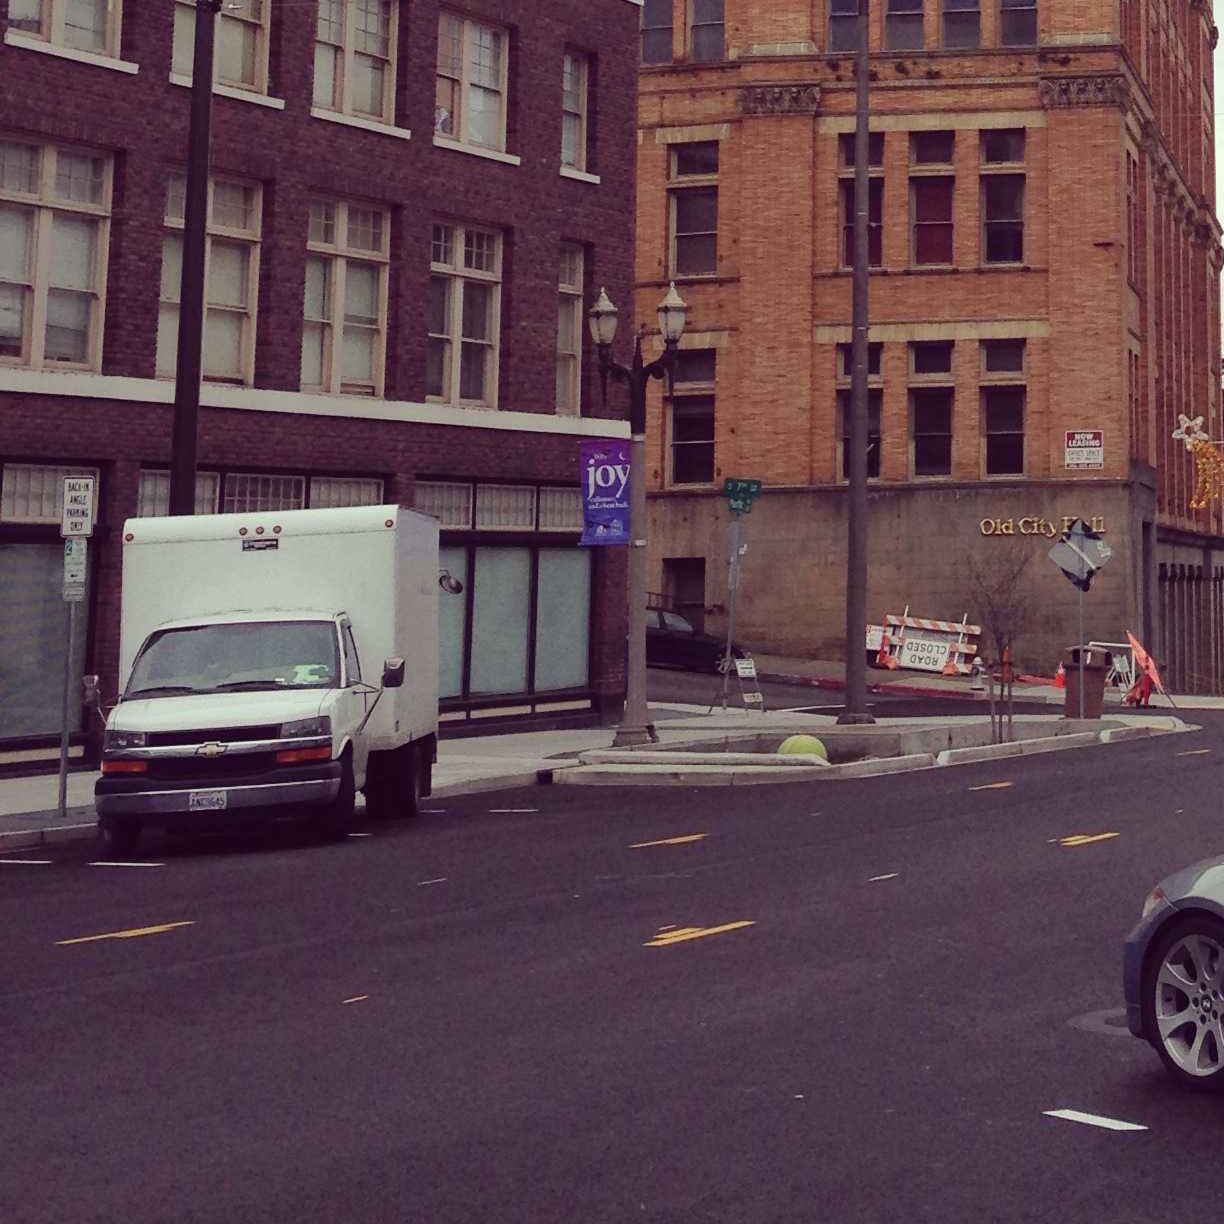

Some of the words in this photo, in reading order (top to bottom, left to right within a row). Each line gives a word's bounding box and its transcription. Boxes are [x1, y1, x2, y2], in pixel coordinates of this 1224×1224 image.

[587, 459, 631, 501] joy
[68, 482, 90, 492] BACK-IN
[70, 495, 87, 505] ANGLE
[67, 508, 89, 518] PARKING
[70, 521, 84, 531] ONLY
[980, 518, 1015, 536] Old
[1018, 516, 1058, 538] City
[1061, 516, 1106, 534] Hll
[906, 641, 947, 656] CLOSED
[909, 654, 940, 667] ROAD
